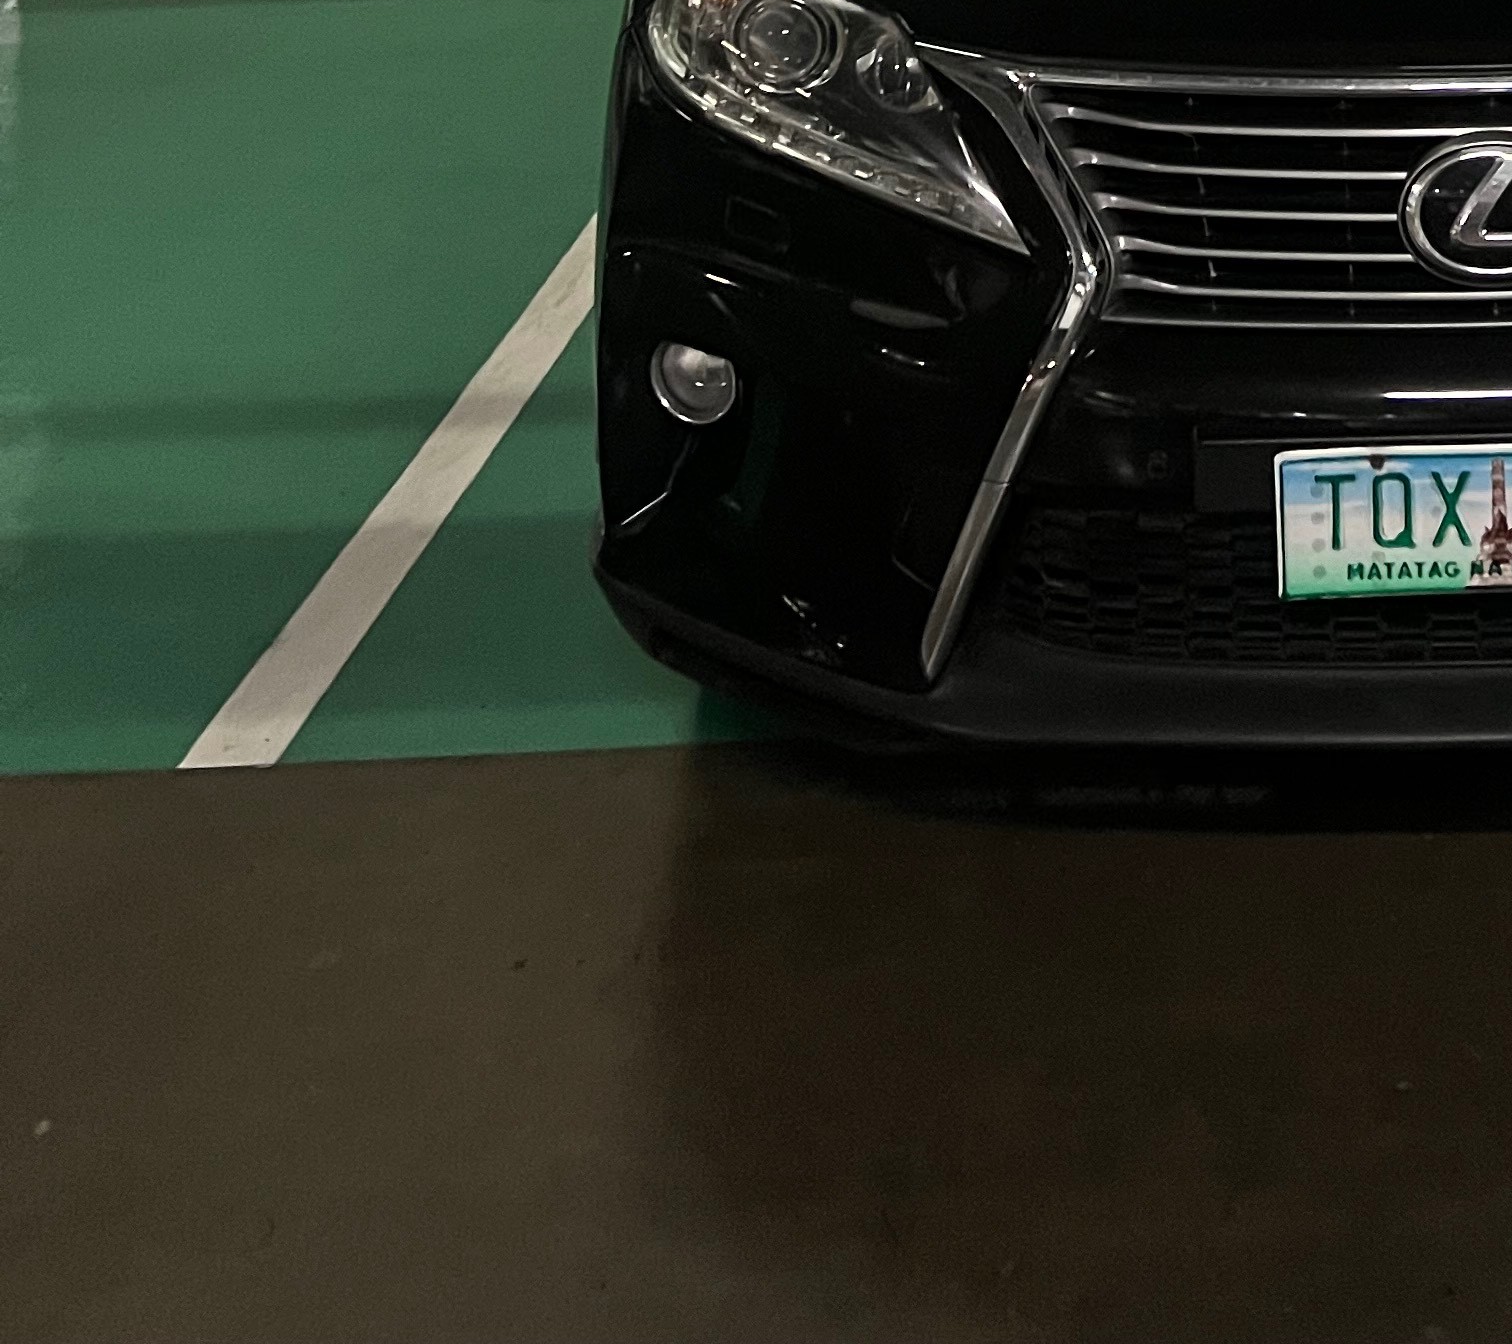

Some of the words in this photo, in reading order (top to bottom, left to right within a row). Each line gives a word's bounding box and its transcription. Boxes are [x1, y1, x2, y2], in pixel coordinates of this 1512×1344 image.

[1314, 470, 1472, 551] TQX
[1347, 560, 1461, 581] MATATAG
[1470, 559, 1501, 577] NA
